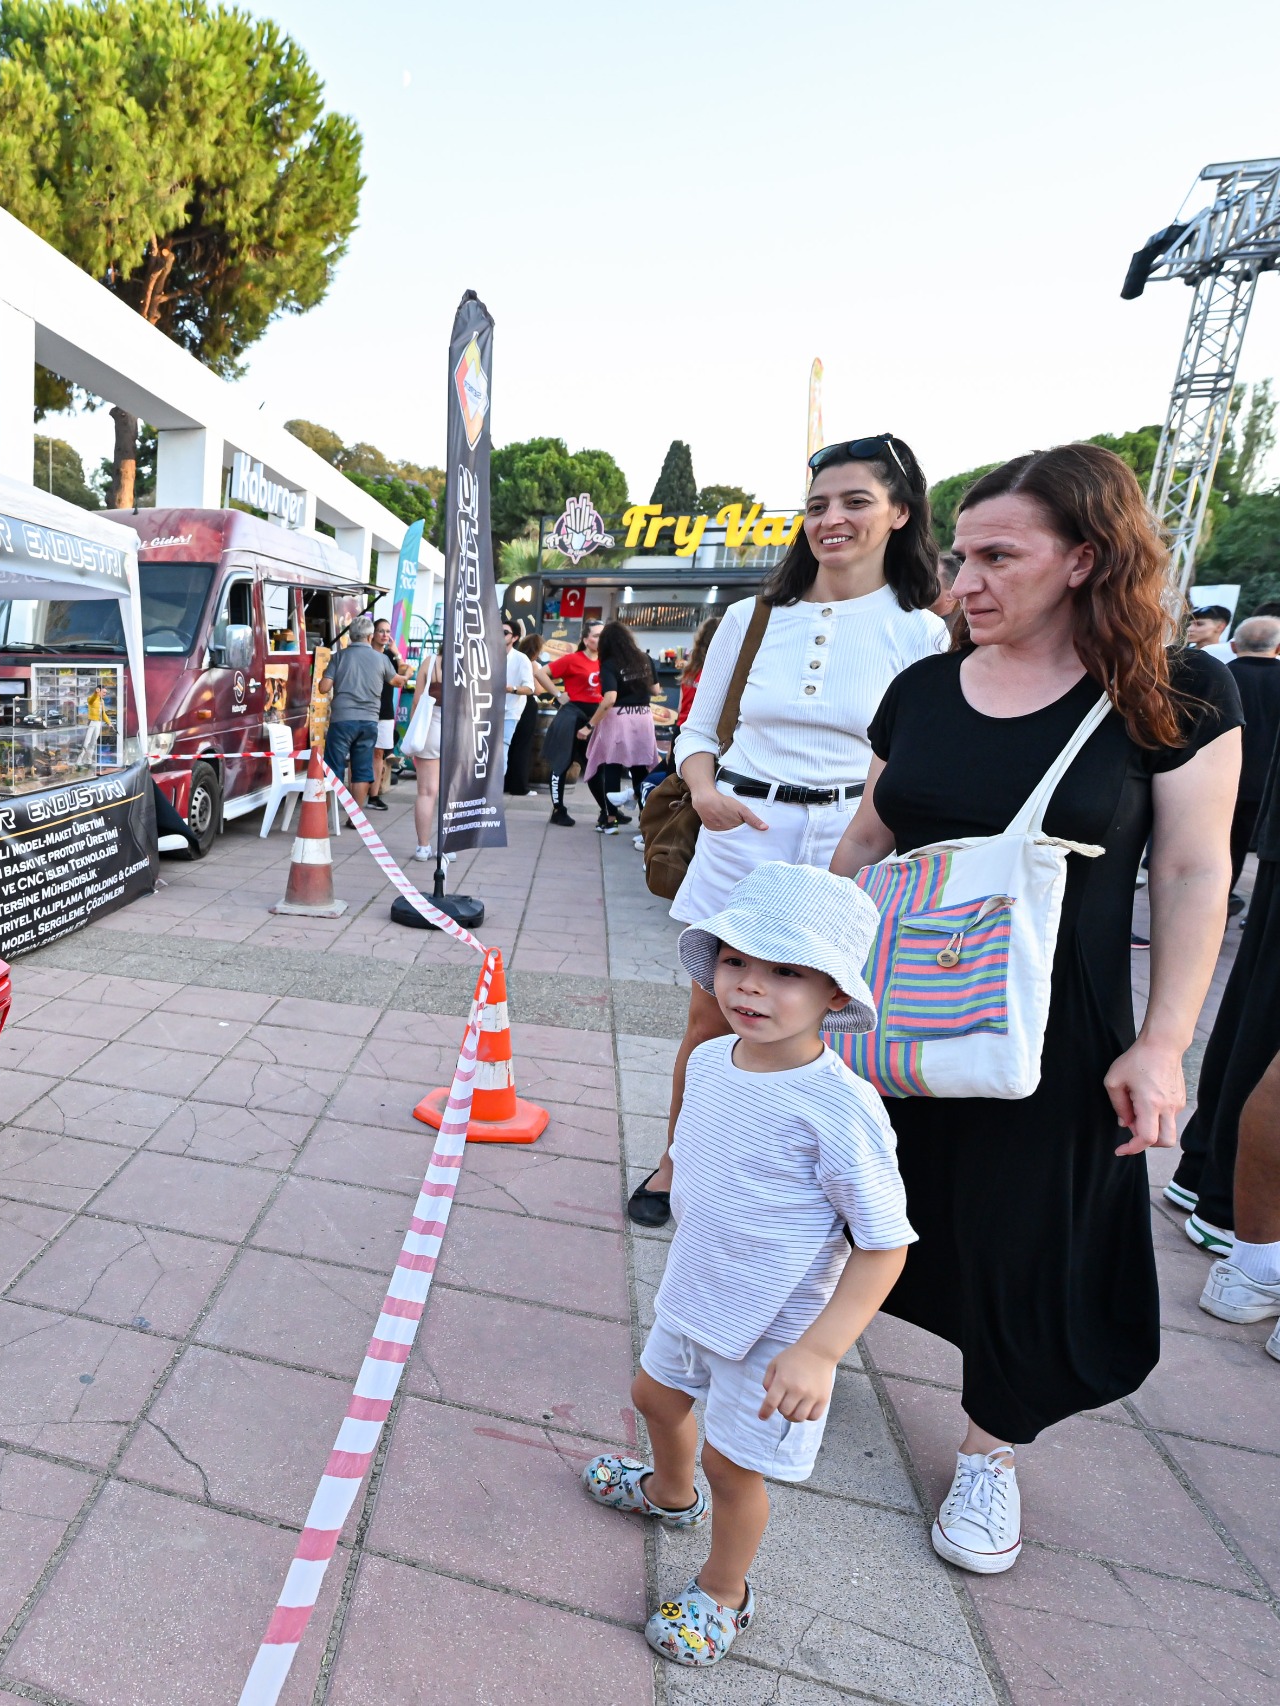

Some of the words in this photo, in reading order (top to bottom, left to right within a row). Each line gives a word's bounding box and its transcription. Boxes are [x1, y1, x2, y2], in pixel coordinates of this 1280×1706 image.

[150, 534, 193, 547] Gider!
[583, 529, 616, 548] Van
[621, 503, 709, 558] Fry
[551, 773, 560, 805] ZUMBA
[11, 827, 73, 858] MODEL-MAKET
[3, 858, 37, 878] BASKI
[34, 853, 48, 868] VE
[1, 882, 17, 897] VE
[17, 871, 45, 891] CNC
[33, 892, 84, 922] KALIPLAMA
[84, 874, 118, 899] (MOLDING
[118, 869, 125, 881] &
[124, 855, 150, 878] CASTING)
[1, 929, 37, 952] MODEL
